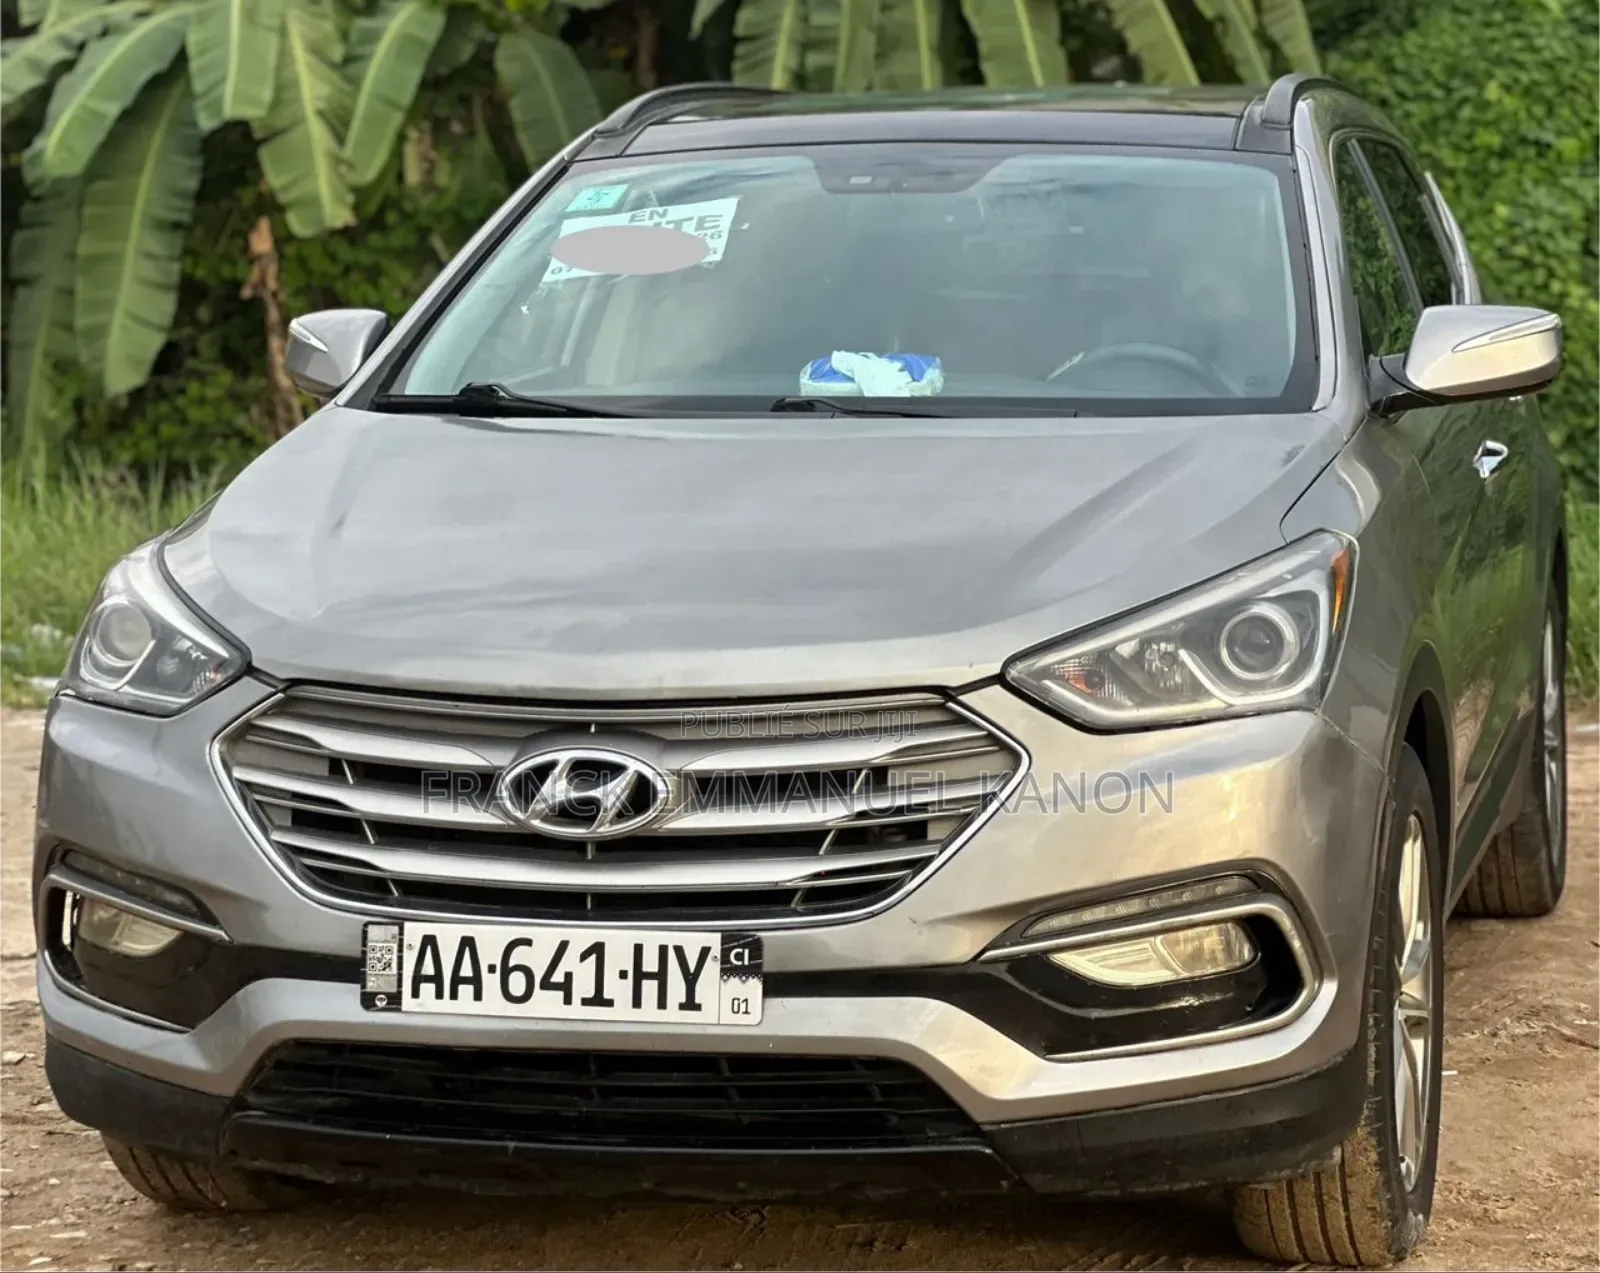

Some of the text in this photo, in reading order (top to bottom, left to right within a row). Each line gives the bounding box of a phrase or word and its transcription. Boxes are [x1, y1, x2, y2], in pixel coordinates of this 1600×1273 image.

[628, 208, 669, 225] EN
[729, 948, 750, 966] CI
[731, 996, 751, 1015] 01
